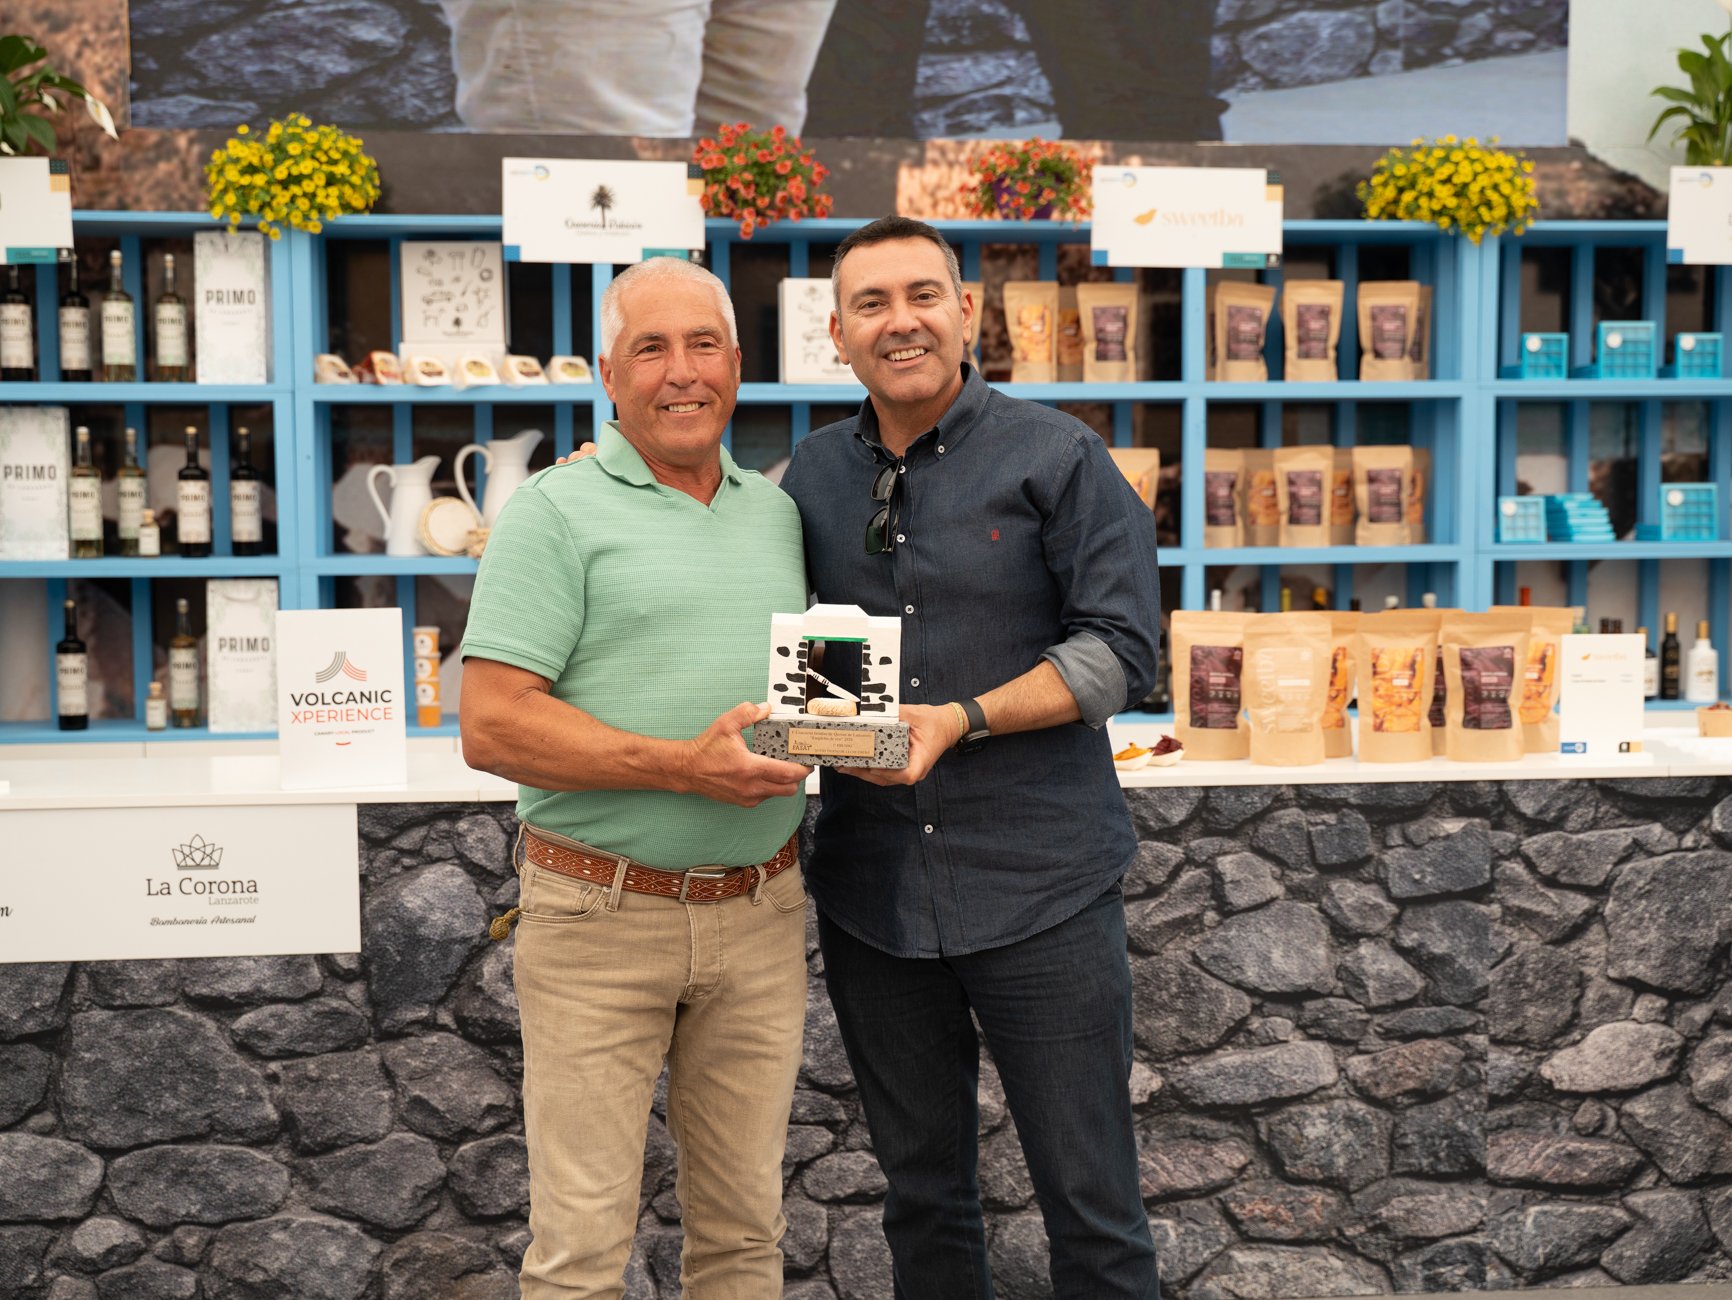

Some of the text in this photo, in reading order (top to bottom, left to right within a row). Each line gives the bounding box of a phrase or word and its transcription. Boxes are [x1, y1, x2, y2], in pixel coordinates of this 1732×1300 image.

[206, 289, 256, 305] PRIMO
[3, 464, 57, 480] PRIMO
[219, 636, 270, 653] PRIMO
[290, 689, 392, 707] VOLCANIC
[291, 707, 393, 724] XPERIENCE
[146, 877, 259, 896] La Corona
[208, 895, 260, 906] Lanzarote
[210, 914, 257, 925] Artesanal
